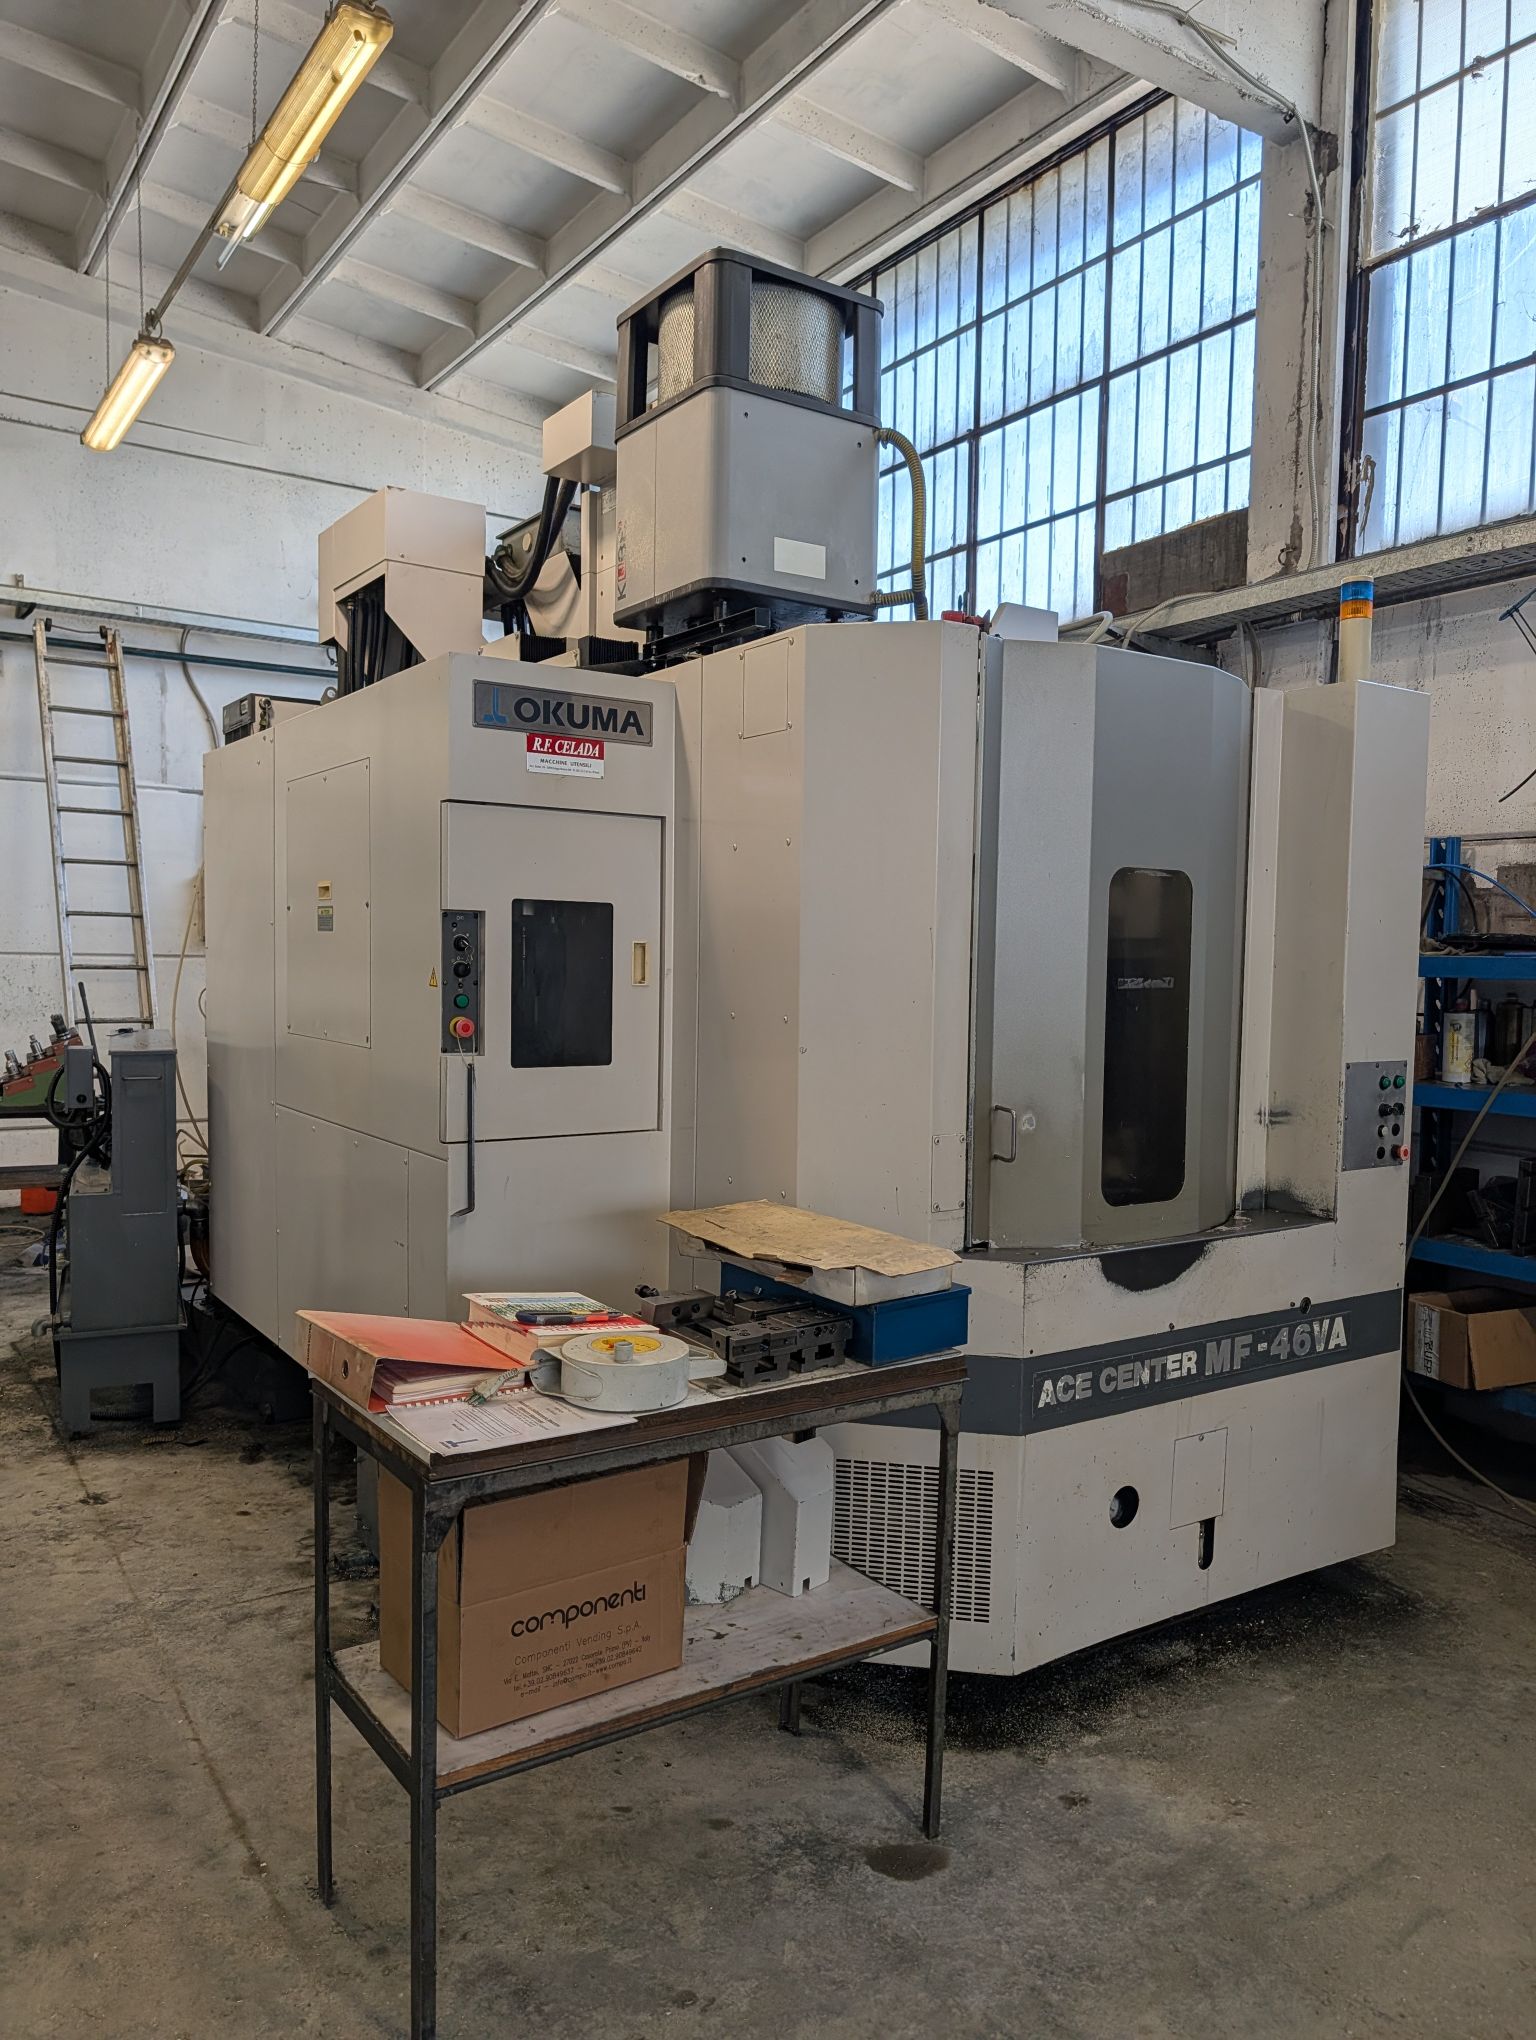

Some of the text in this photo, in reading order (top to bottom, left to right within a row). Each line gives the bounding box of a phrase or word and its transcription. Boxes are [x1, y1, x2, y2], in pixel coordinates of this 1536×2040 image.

[514, 697, 644, 736] OKUMA
[532, 736, 600, 757] R.F. CELADA
[540, 758, 592, 769] MACCHINE UTENSILI
[1037, 1371, 1093, 1409] ACE
[1099, 1350, 1198, 1394] CENTER
[511, 1580, 646, 1637] componenti
[514, 1639, 571, 1666] Componenti
[576, 1631, 612, 1648] Vending
